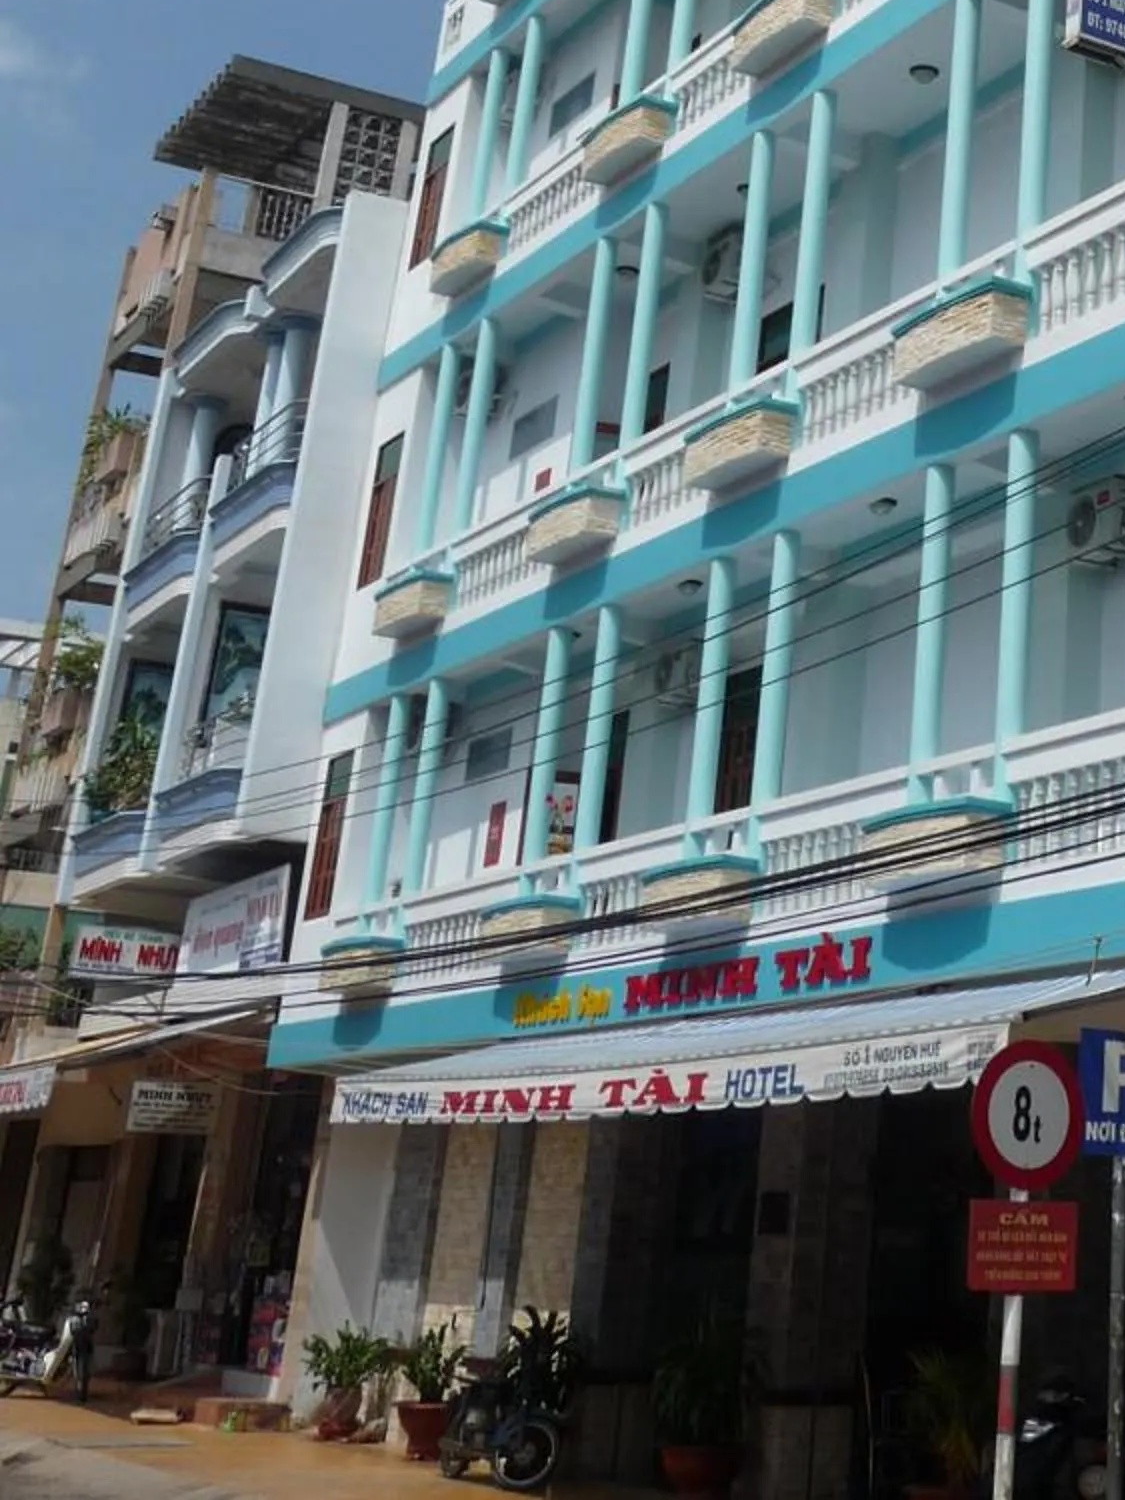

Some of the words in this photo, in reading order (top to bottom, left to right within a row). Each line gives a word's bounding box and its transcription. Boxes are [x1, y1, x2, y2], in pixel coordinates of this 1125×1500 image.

[622, 956, 760, 1015] MINH
[774, 931, 874, 993] TÀI
[440, 1084, 577, 1115] MINH
[598, 1068, 709, 1109] TÀI
[724, 1063, 805, 1101] HOTEL
[1085, 1120, 1115, 1142] NƠI
